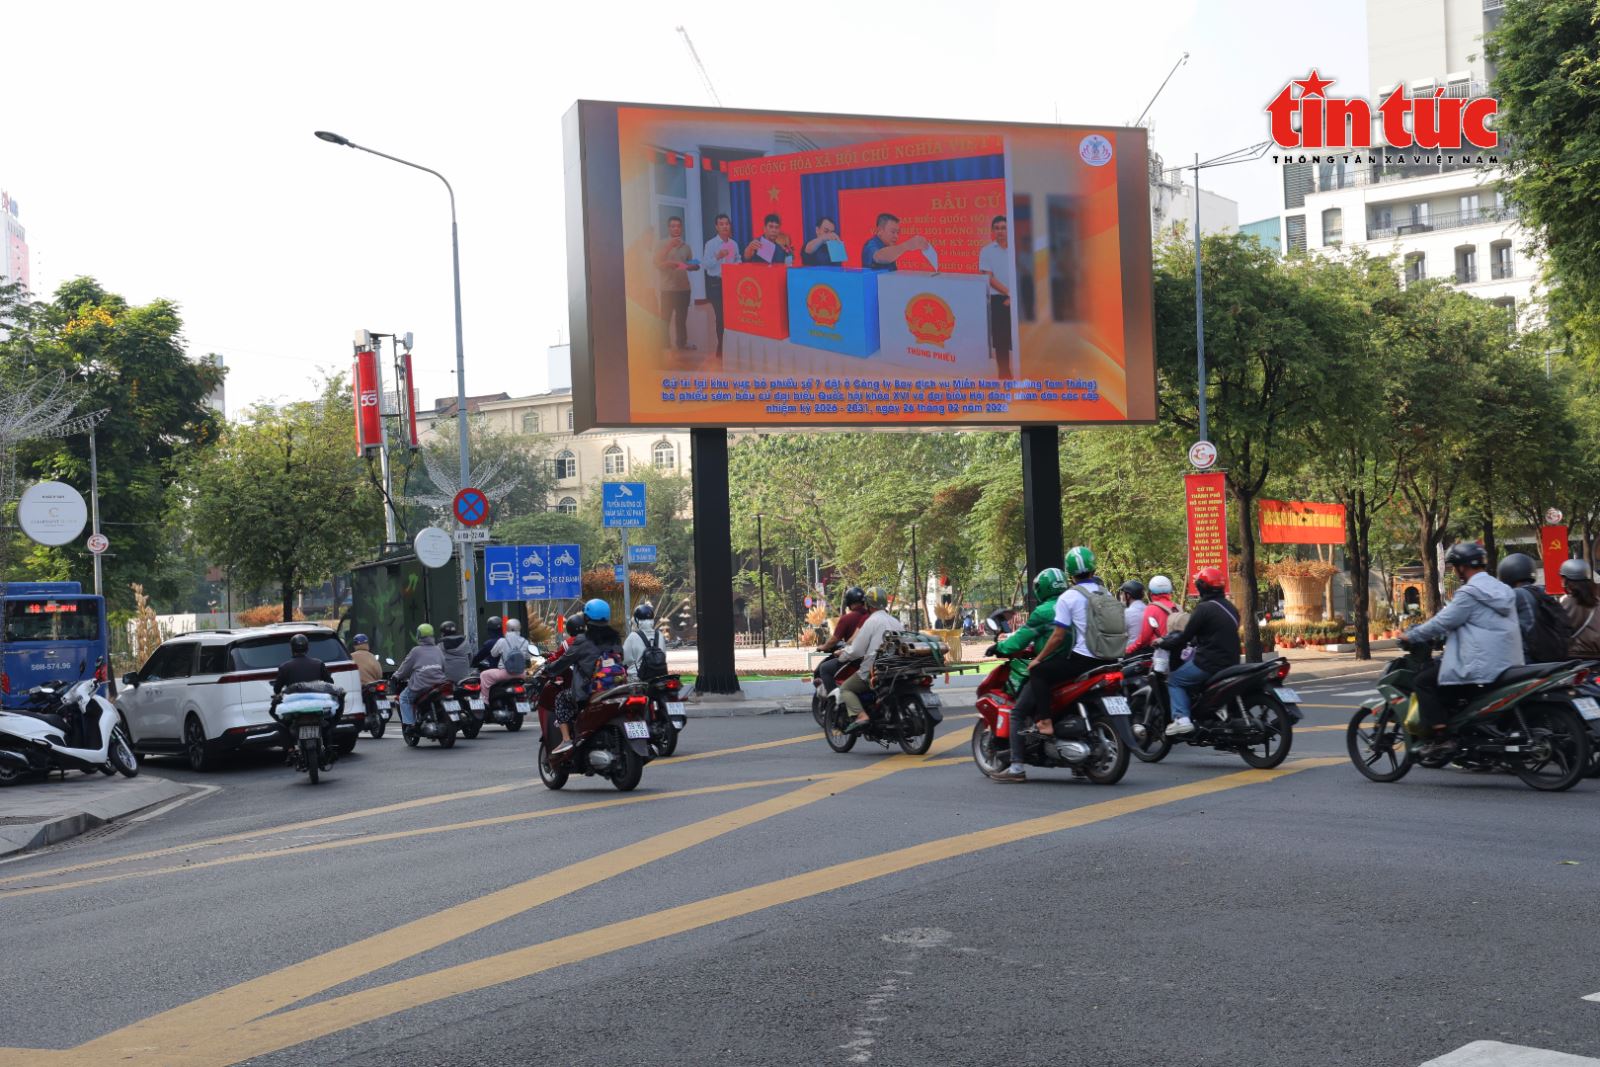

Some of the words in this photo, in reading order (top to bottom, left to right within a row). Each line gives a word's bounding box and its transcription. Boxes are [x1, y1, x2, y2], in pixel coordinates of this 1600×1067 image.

[931, 192, 967, 210] BẦU
[974, 193, 1001, 209] CỬ
[361, 393, 378, 407] 5G
[814, 403, 837, 412] 2026
